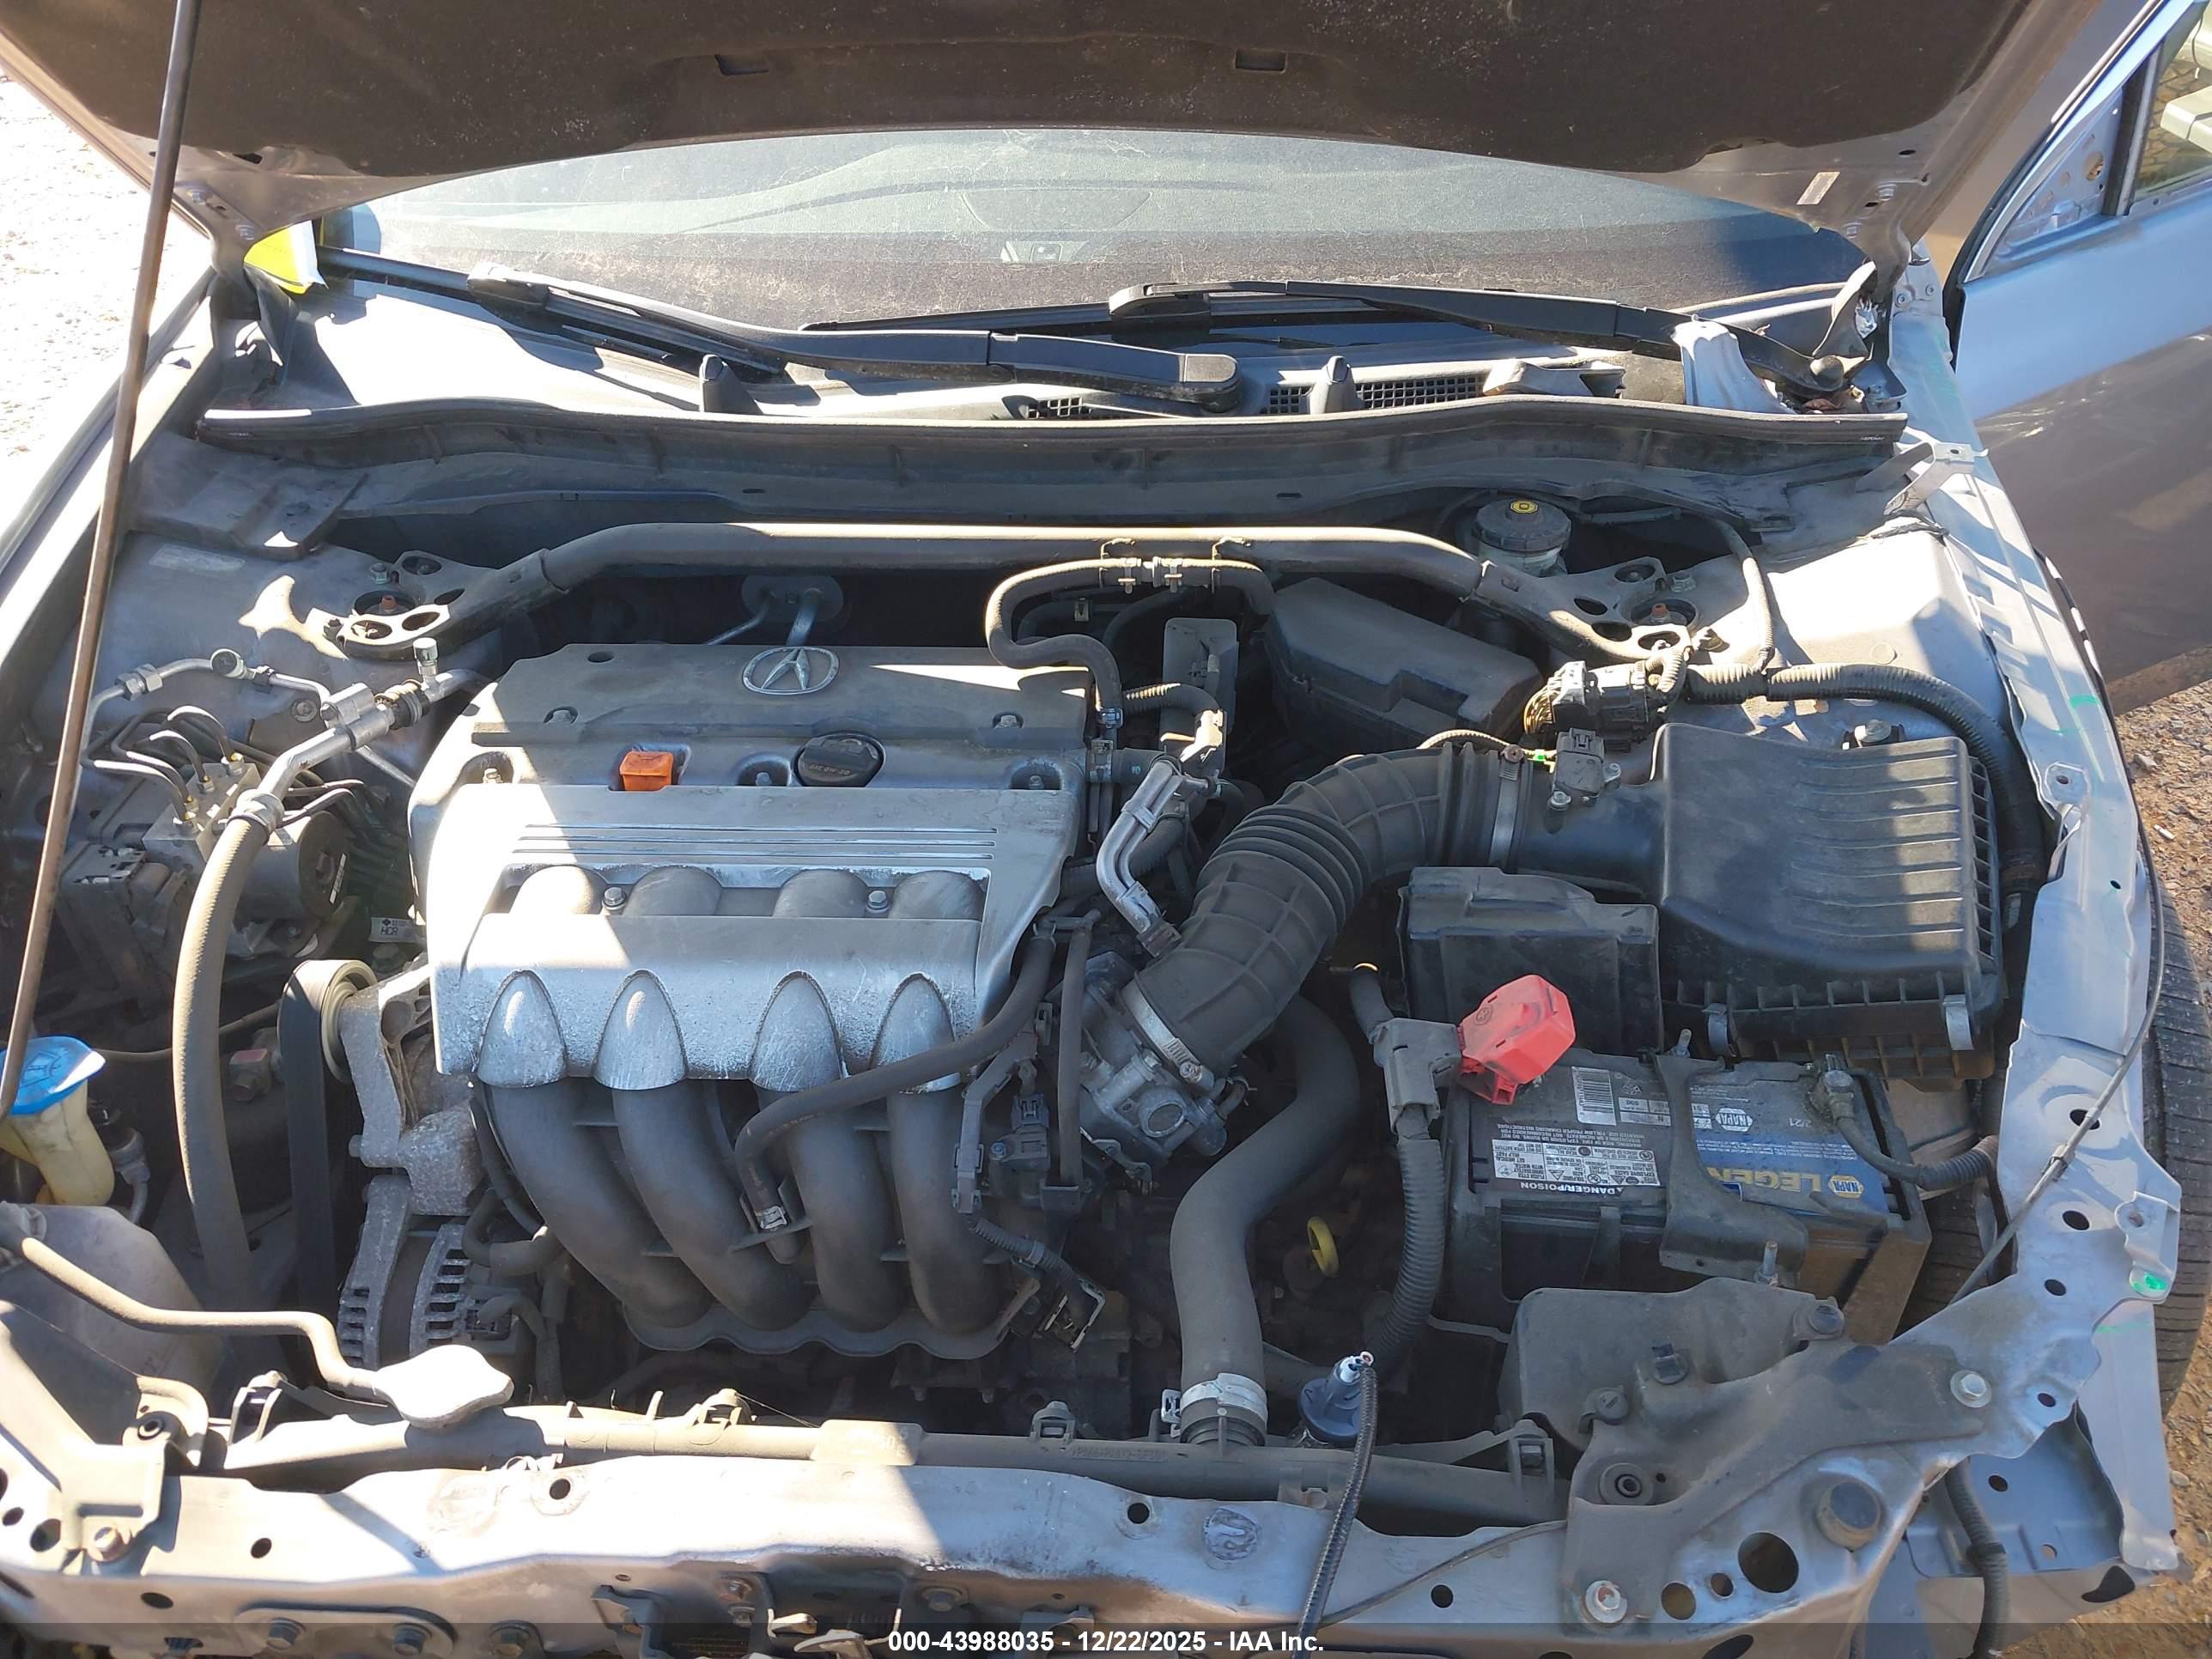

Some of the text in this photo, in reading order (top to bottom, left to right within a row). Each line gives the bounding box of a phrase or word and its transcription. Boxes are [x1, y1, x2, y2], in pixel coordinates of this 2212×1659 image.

[1720, 1113, 1747, 1127] NAPA
[1520, 1182, 1615, 1194] DANGER/POISON
[1833, 1180, 1859, 1193] NAPA
